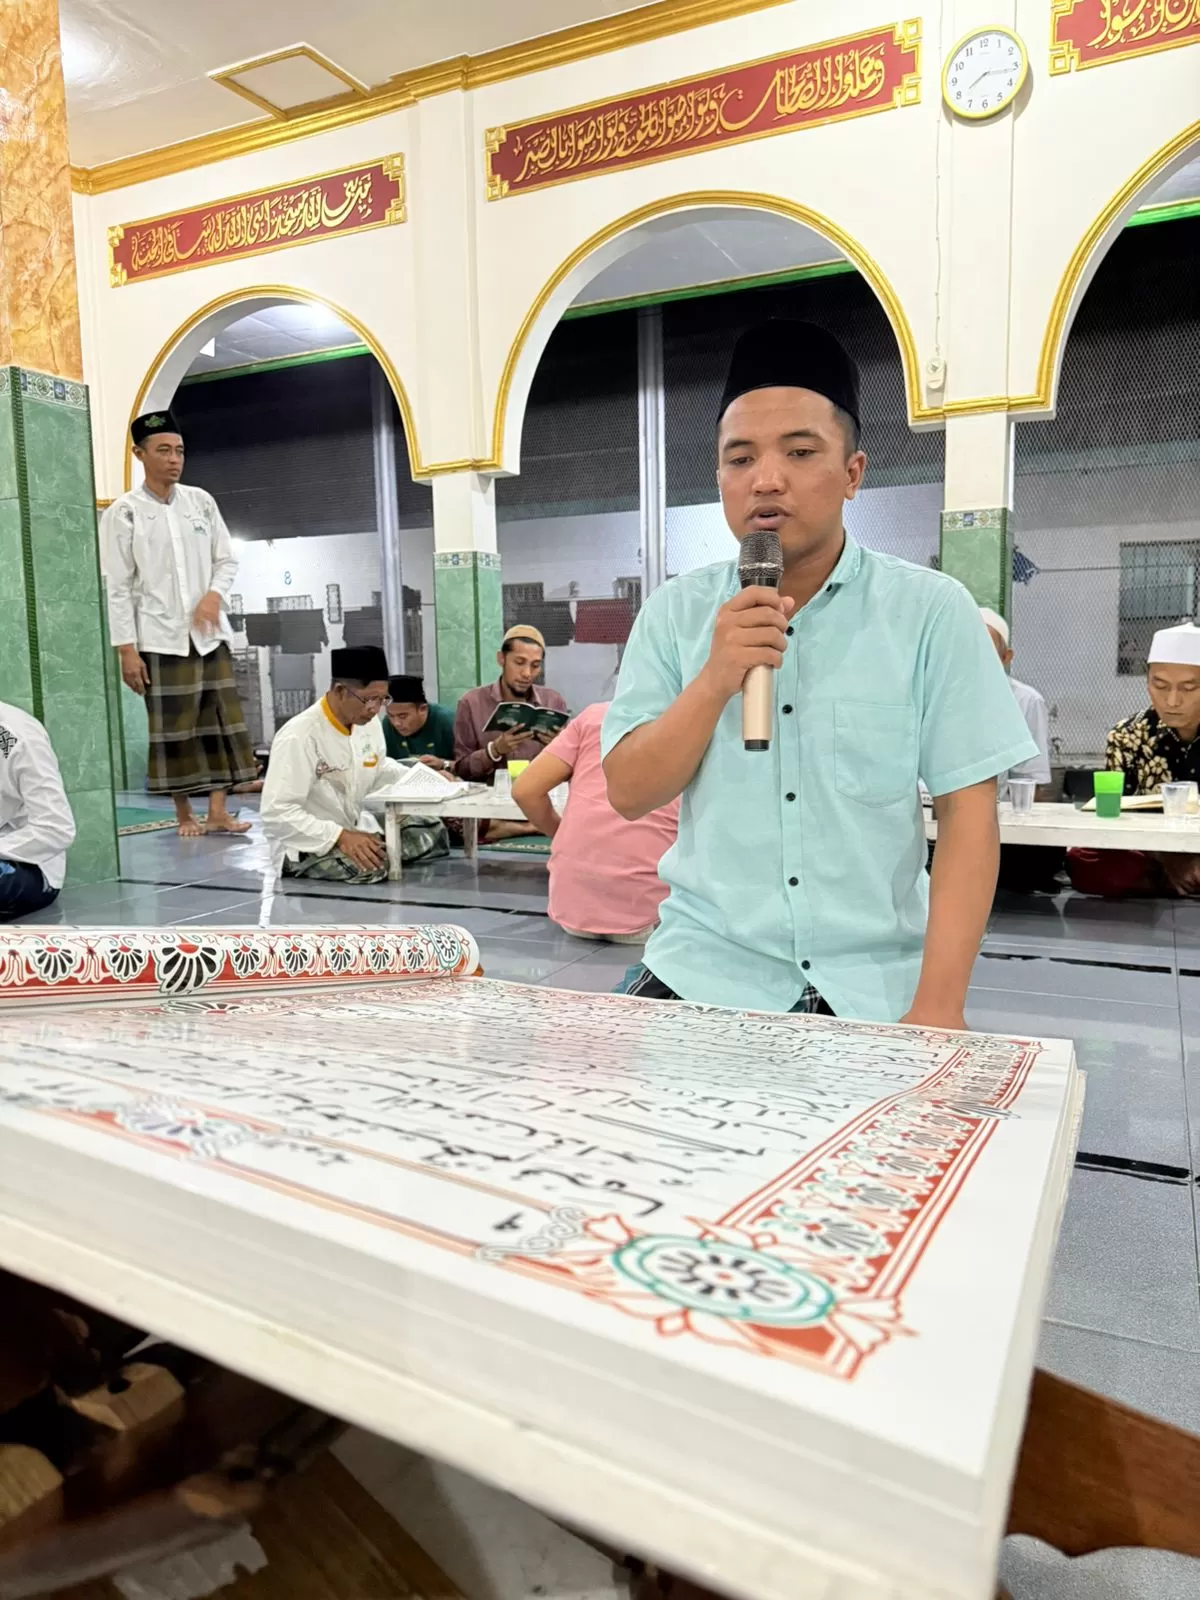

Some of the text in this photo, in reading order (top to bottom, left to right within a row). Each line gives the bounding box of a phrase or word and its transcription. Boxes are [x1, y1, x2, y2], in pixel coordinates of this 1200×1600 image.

[980, 38, 989, 48] 12
[965, 47, 973, 57] 11
[1008, 46, 1014, 56] 2
[955, 61, 965, 71] 10
[951, 77, 958, 87] 9
[1007, 78, 1013, 87] 4
[956, 90, 962, 100] 8
[997, 92, 1003, 101] 5
[967, 99, 973, 108] 7
[982, 99, 988, 108] 6
